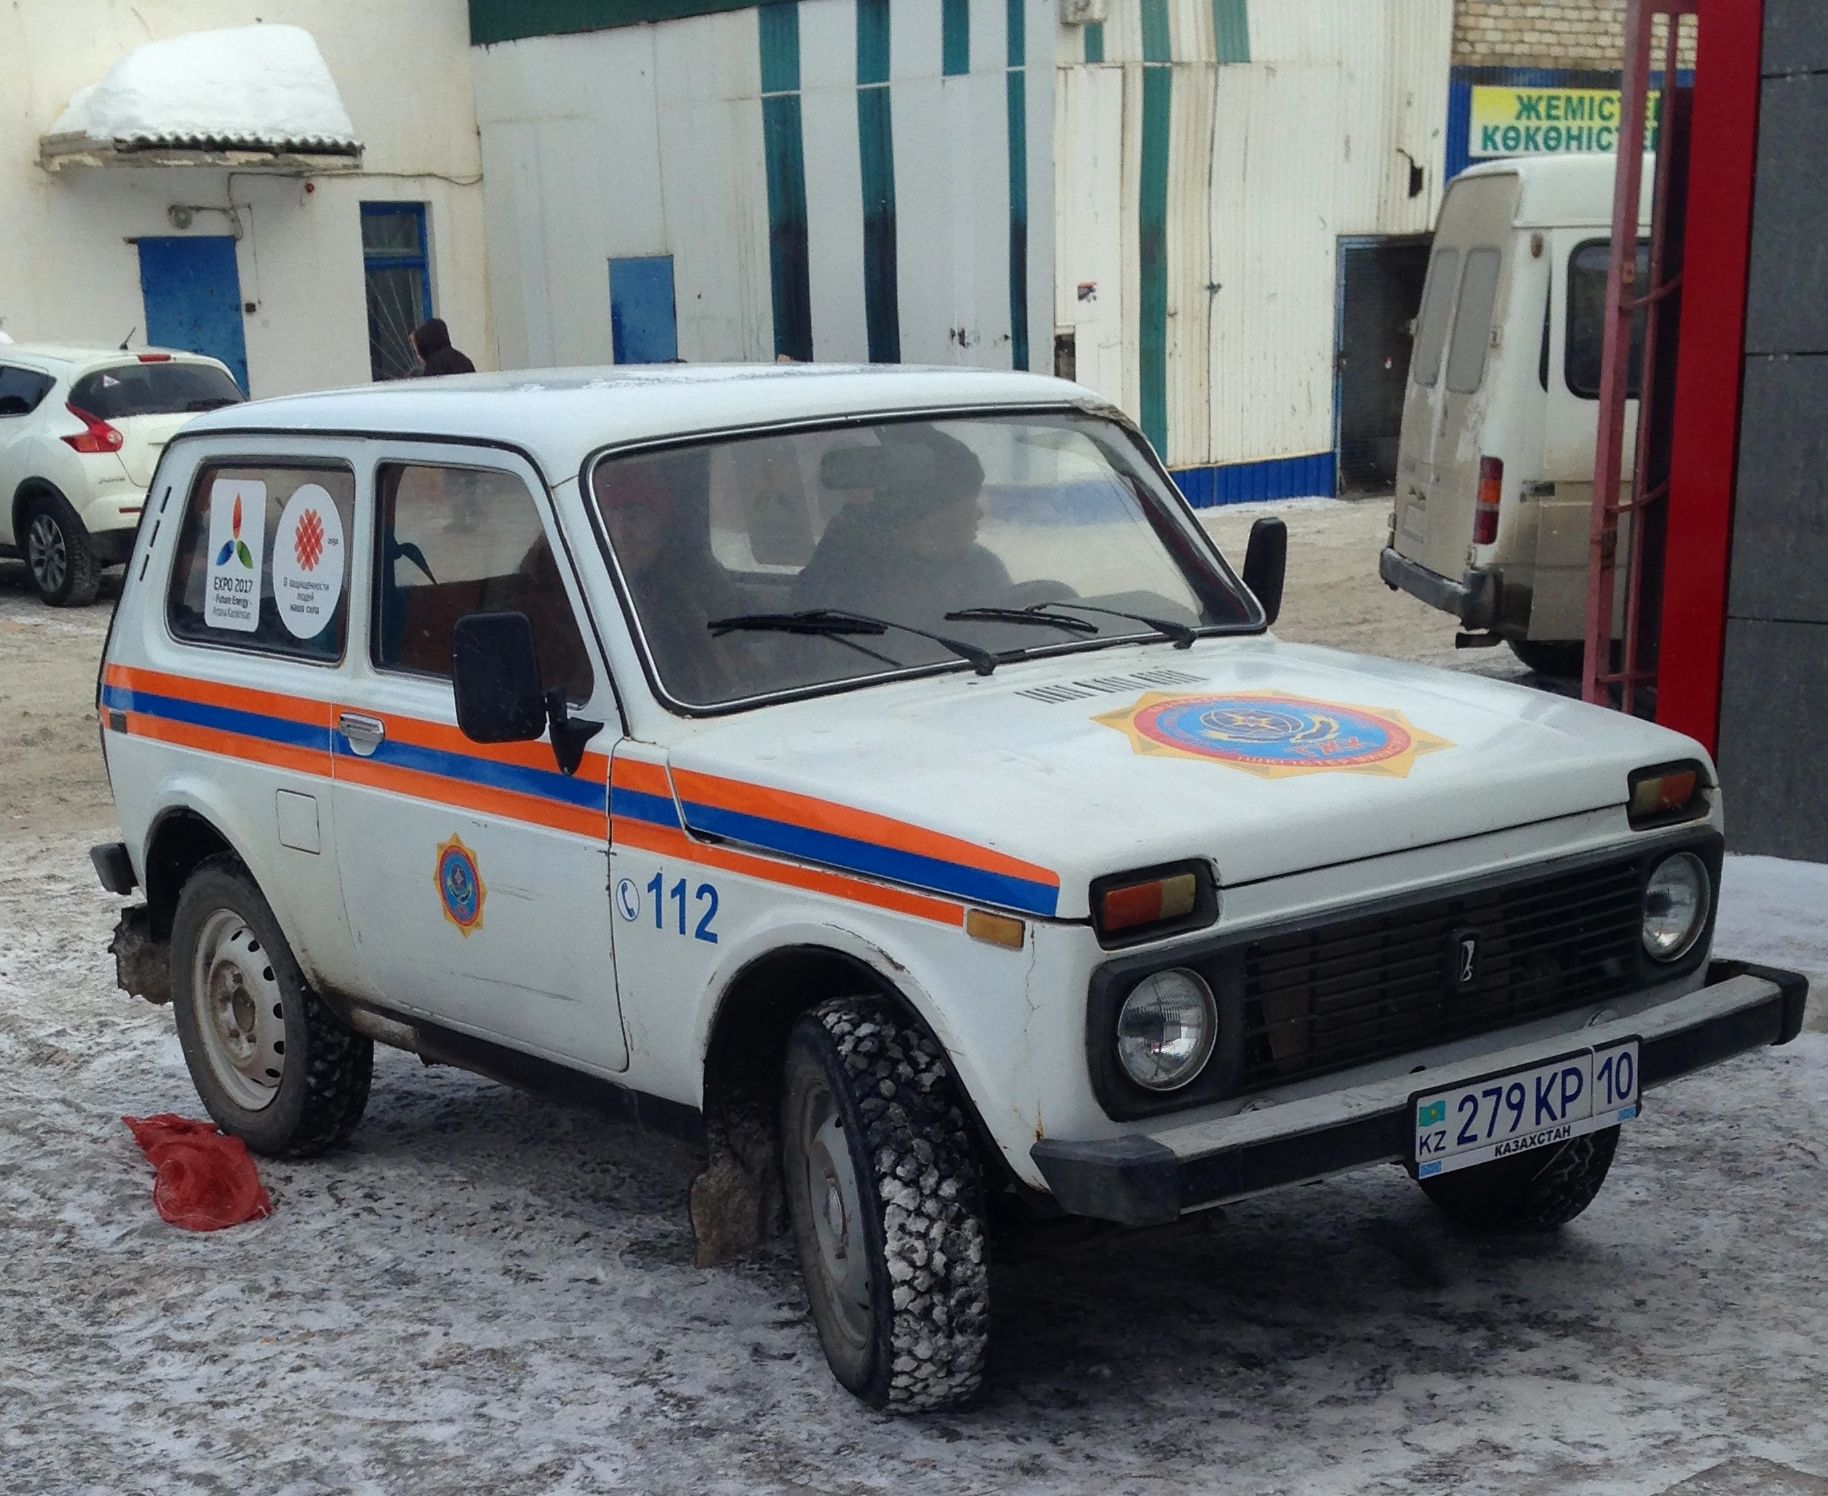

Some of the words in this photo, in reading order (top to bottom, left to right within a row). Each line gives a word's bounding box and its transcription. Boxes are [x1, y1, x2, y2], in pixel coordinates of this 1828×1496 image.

[1515, 95, 1660, 121] ЖЕМІС
[1481, 125, 1658, 151] КӨКӨНІС
[214, 576, 232, 591] EXPO
[235, 578, 253, 593] 2017
[290, 604, 304, 613] наша
[306, 606, 319, 614] сила
[647, 872, 719, 944] 112
[1457, 1082, 1525, 1146] 279
[1535, 1066, 1584, 1126] KP
[1597, 1051, 1633, 1104] 10
[1419, 1130, 1447, 1156] KZ
[1495, 1125, 1571, 1157] КАЗАХСТАН
